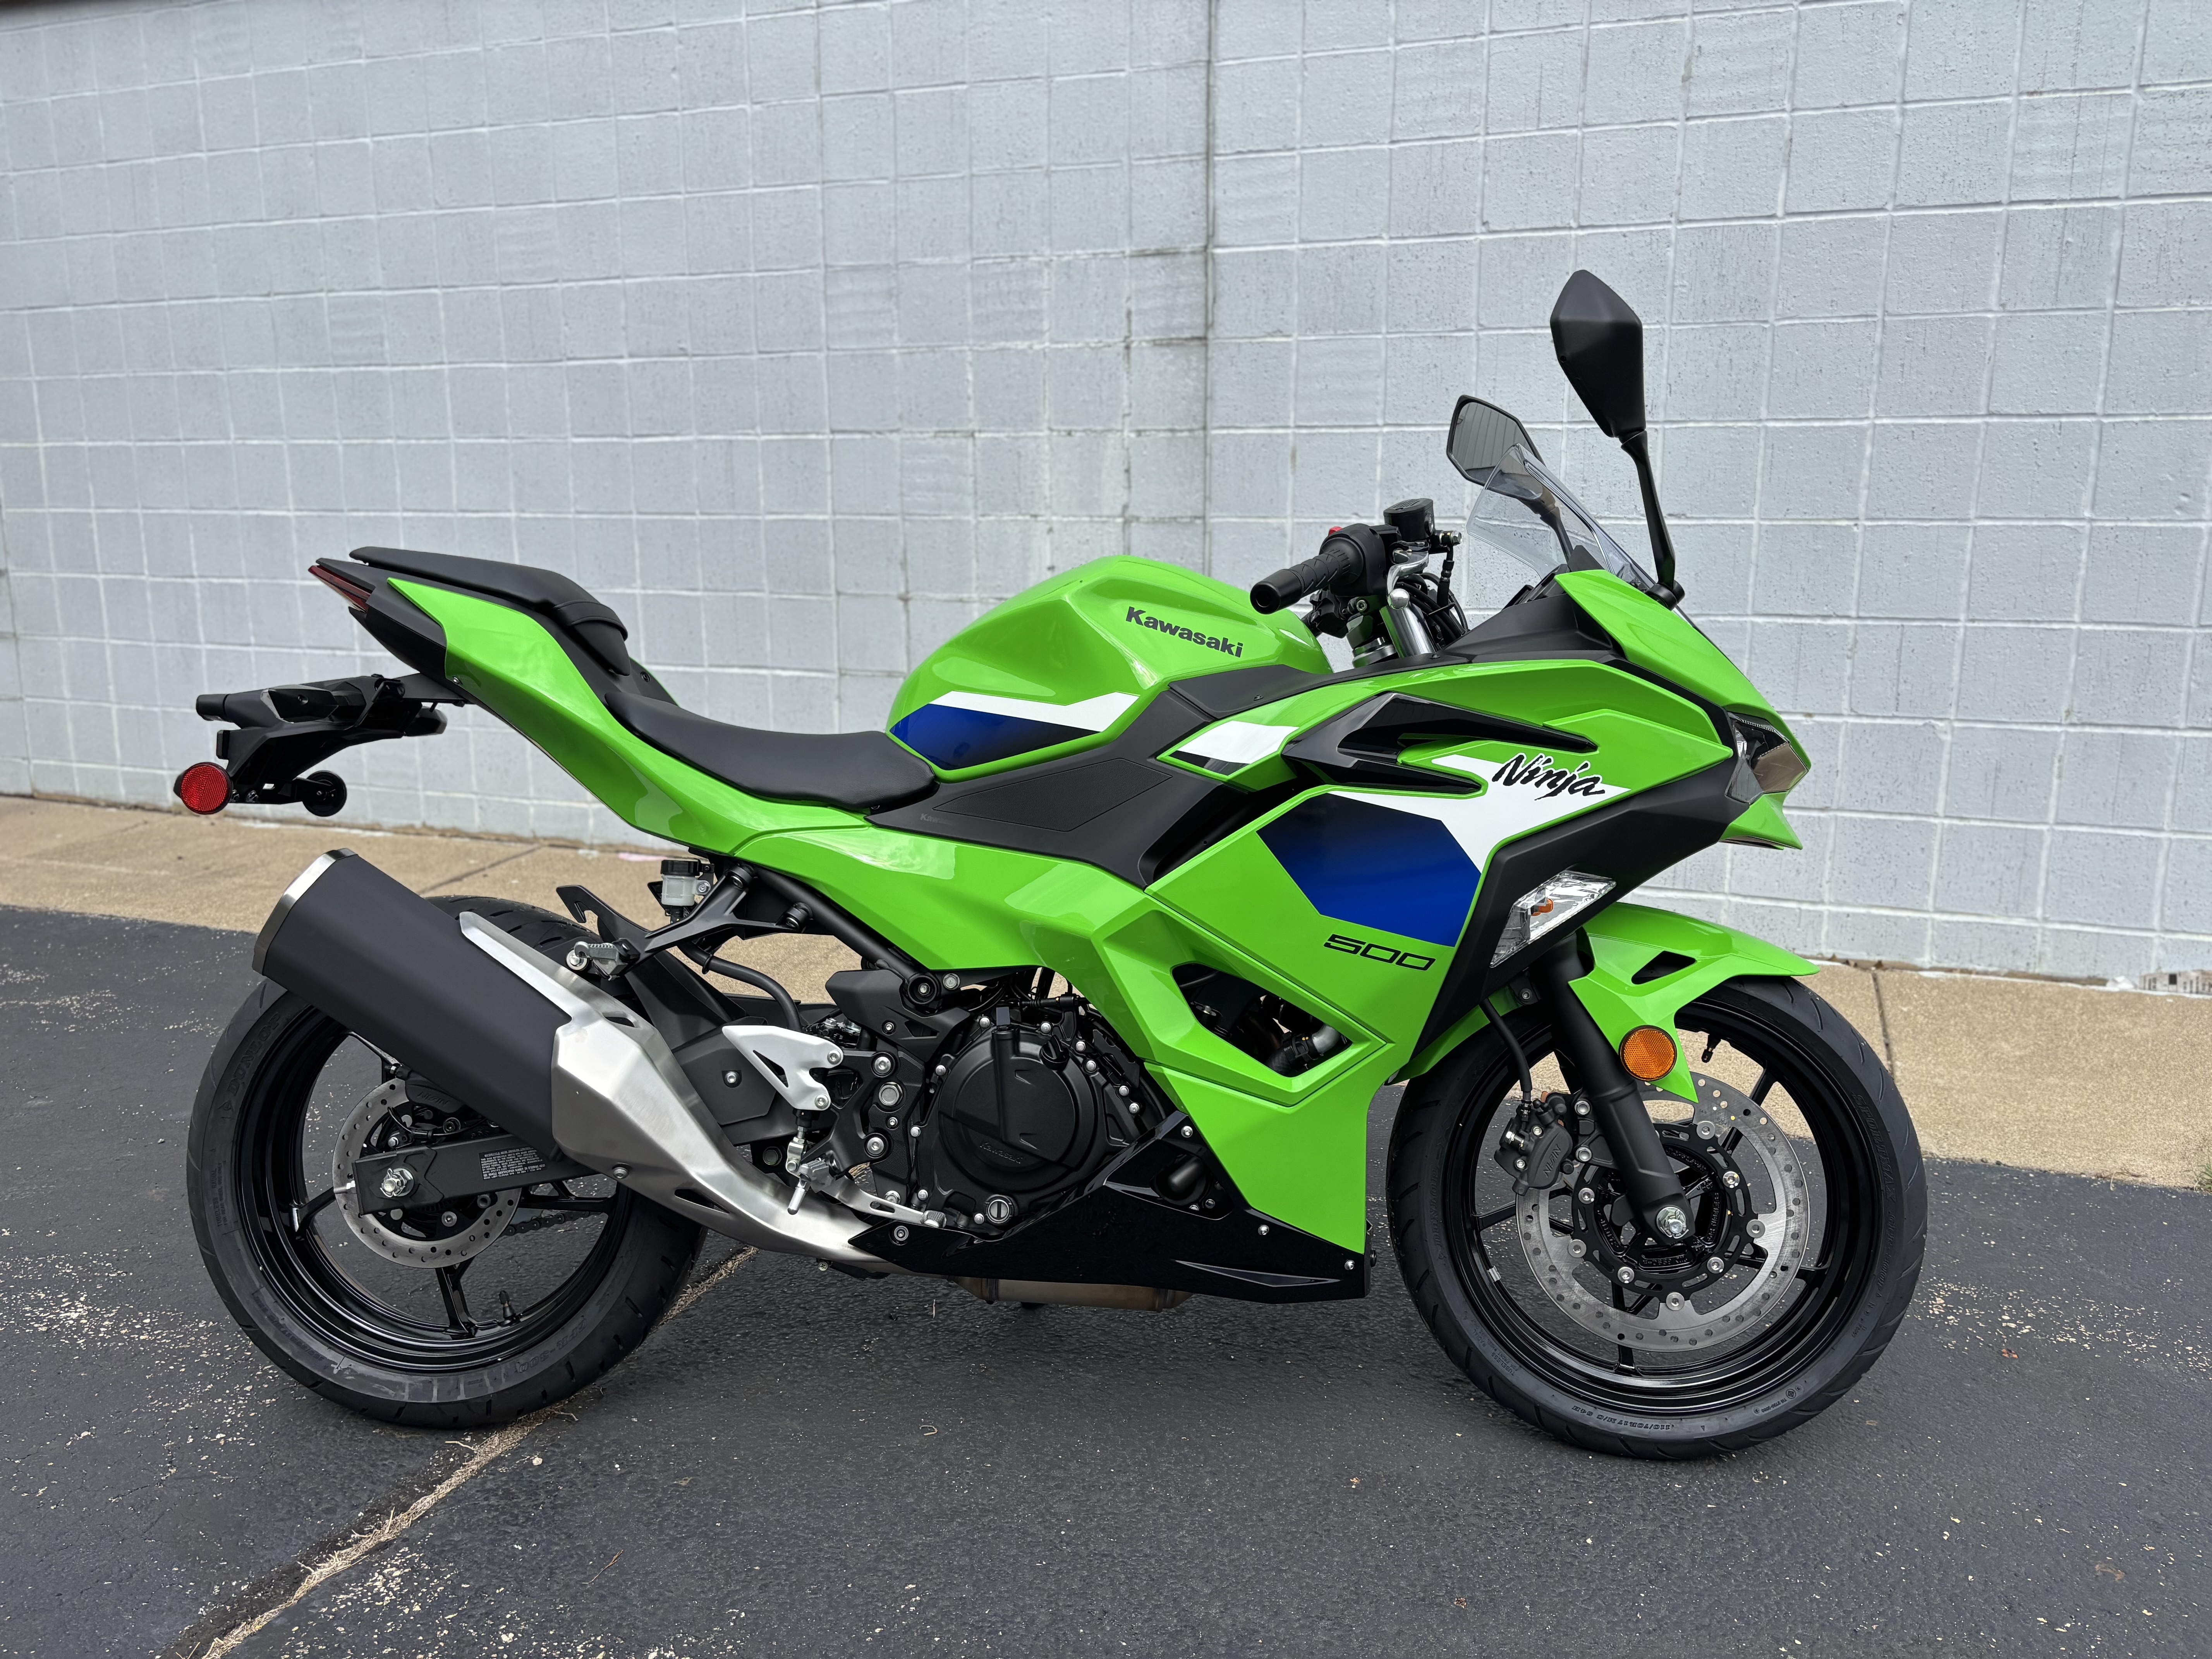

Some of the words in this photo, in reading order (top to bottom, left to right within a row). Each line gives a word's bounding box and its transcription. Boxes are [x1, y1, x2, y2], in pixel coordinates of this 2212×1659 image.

[1125, 606, 1243, 658] Kawasaki
[1492, 754, 1605, 800] Ninja
[1323, 934, 1436, 971] 500
[227, 1012, 282, 1096] DUNLOP
[1852, 1092, 1896, 1203] SPORTMAX
[1472, 1328, 1486, 1347] RADIAL
[1491, 1352, 1516, 1376] TUBELESS
[1571, 1405, 1594, 1416] 54H
[1596, 1413, 1617, 1424] M/C
[1617, 1419, 1670, 1429] 110/70R17
